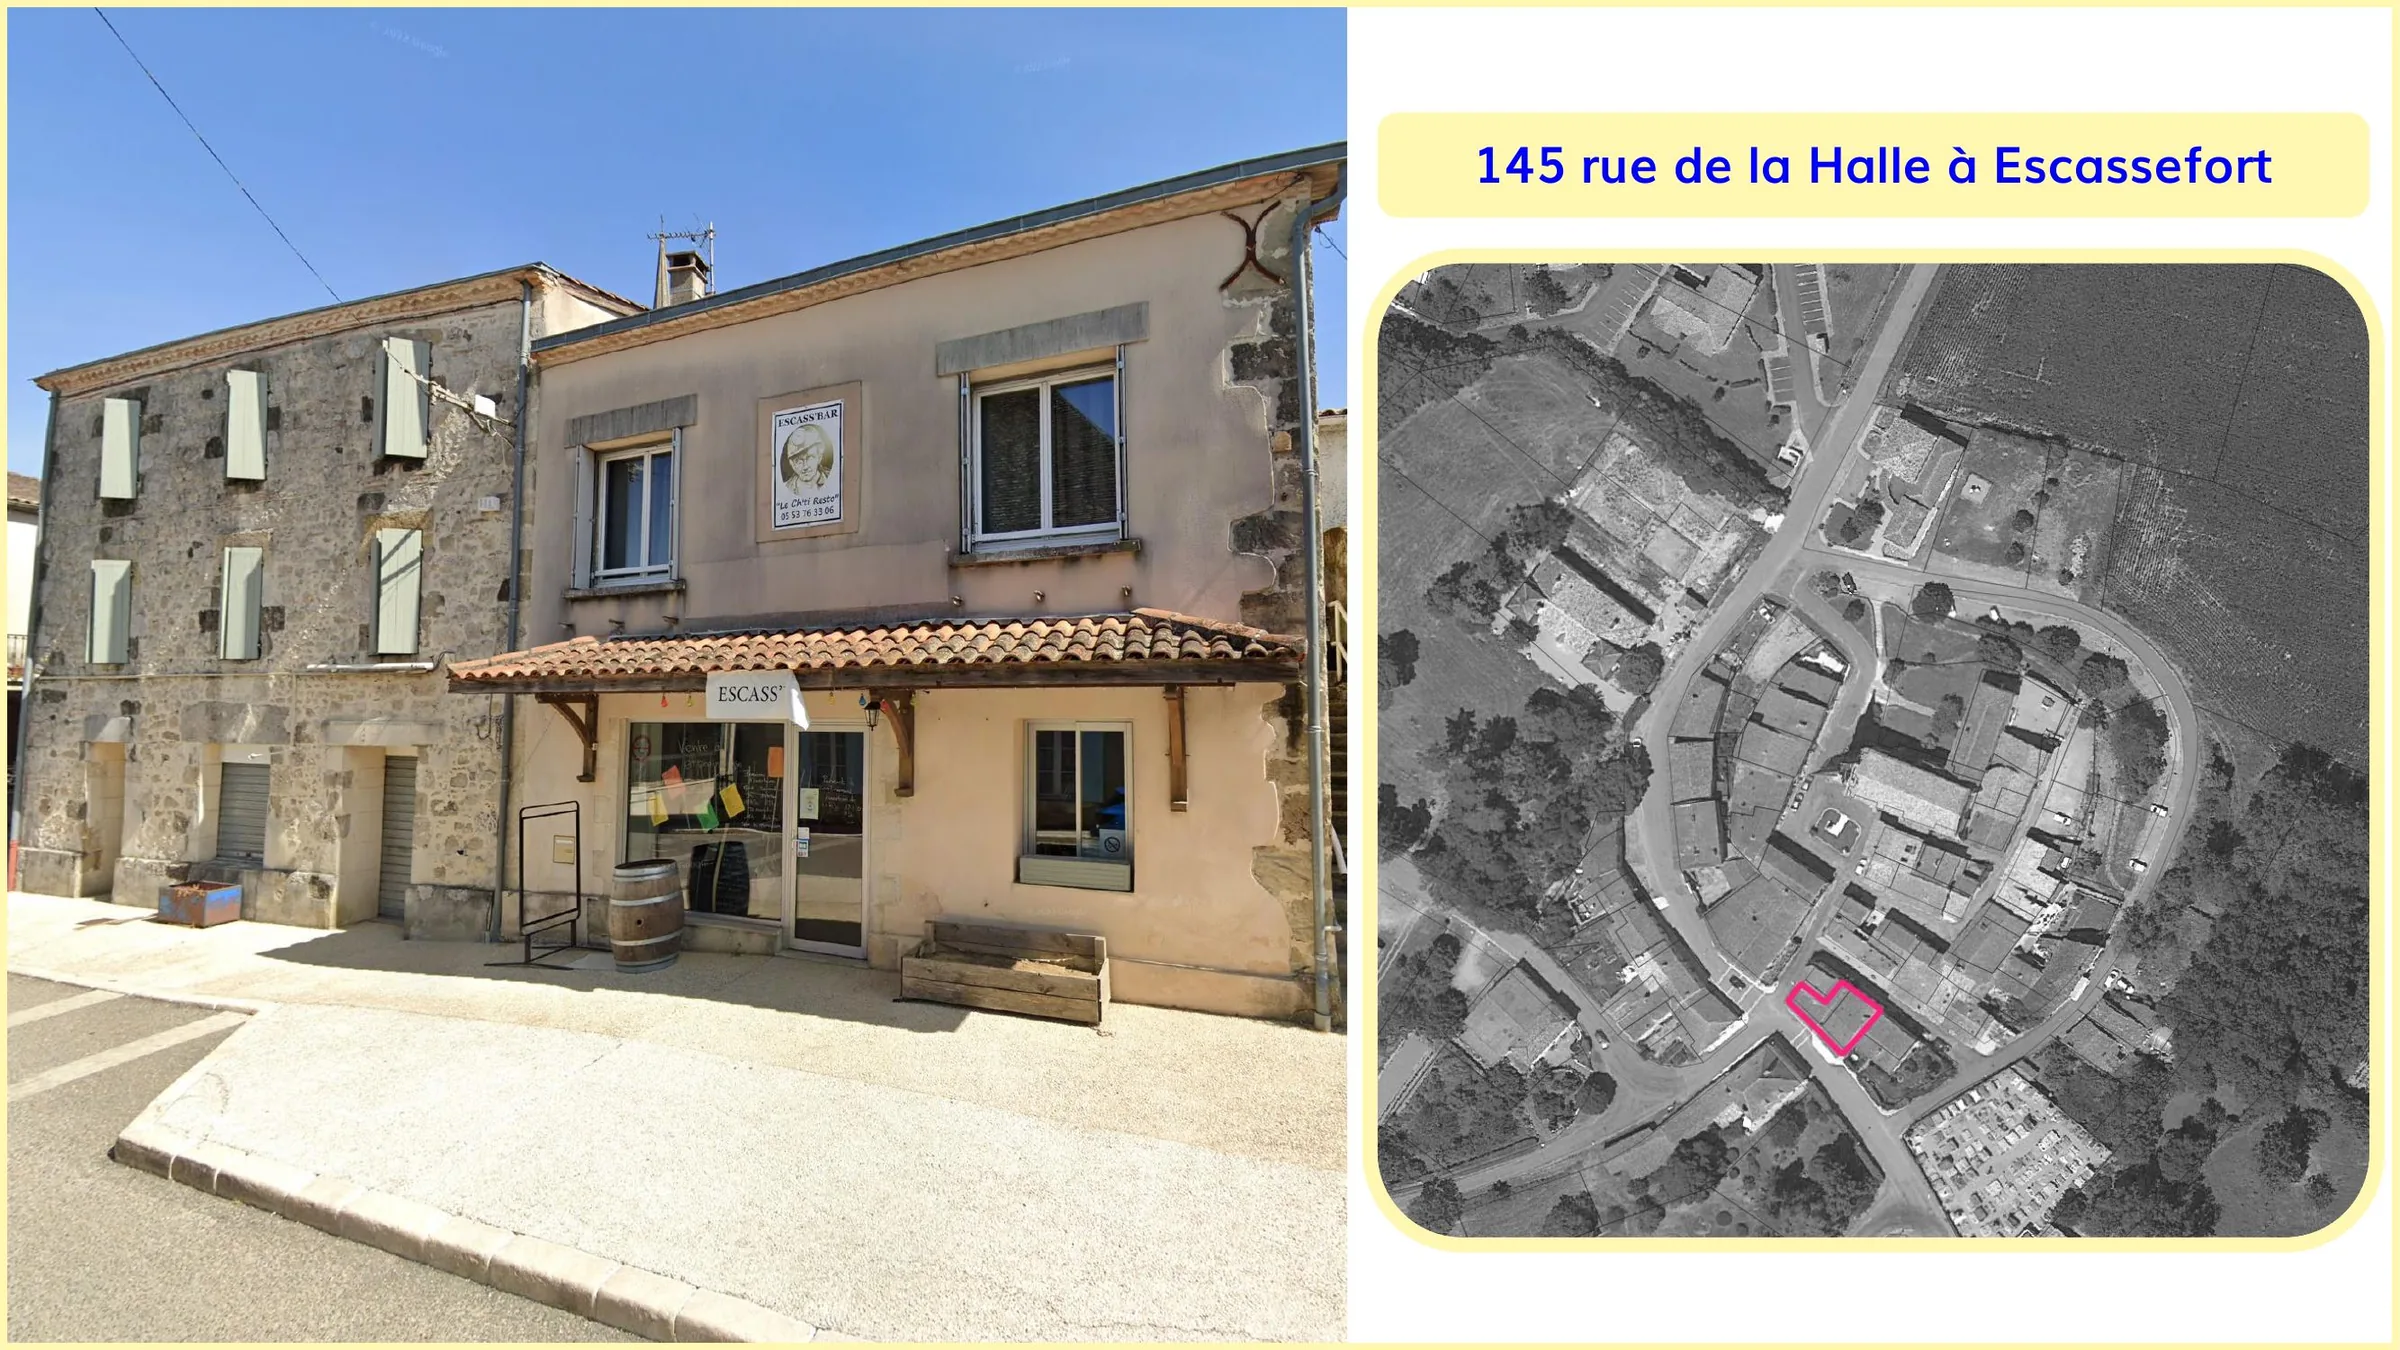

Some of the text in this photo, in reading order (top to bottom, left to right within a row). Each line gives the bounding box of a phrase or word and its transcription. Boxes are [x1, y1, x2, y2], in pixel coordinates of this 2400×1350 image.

[778, 409, 838, 427] ESCASS'BAR
[781, 511, 789, 520] 05
[792, 510, 800, 519] 53
[813, 507, 823, 516] 33
[824, 505, 834, 515] 06
[718, 685, 783, 702] ESCASS'
